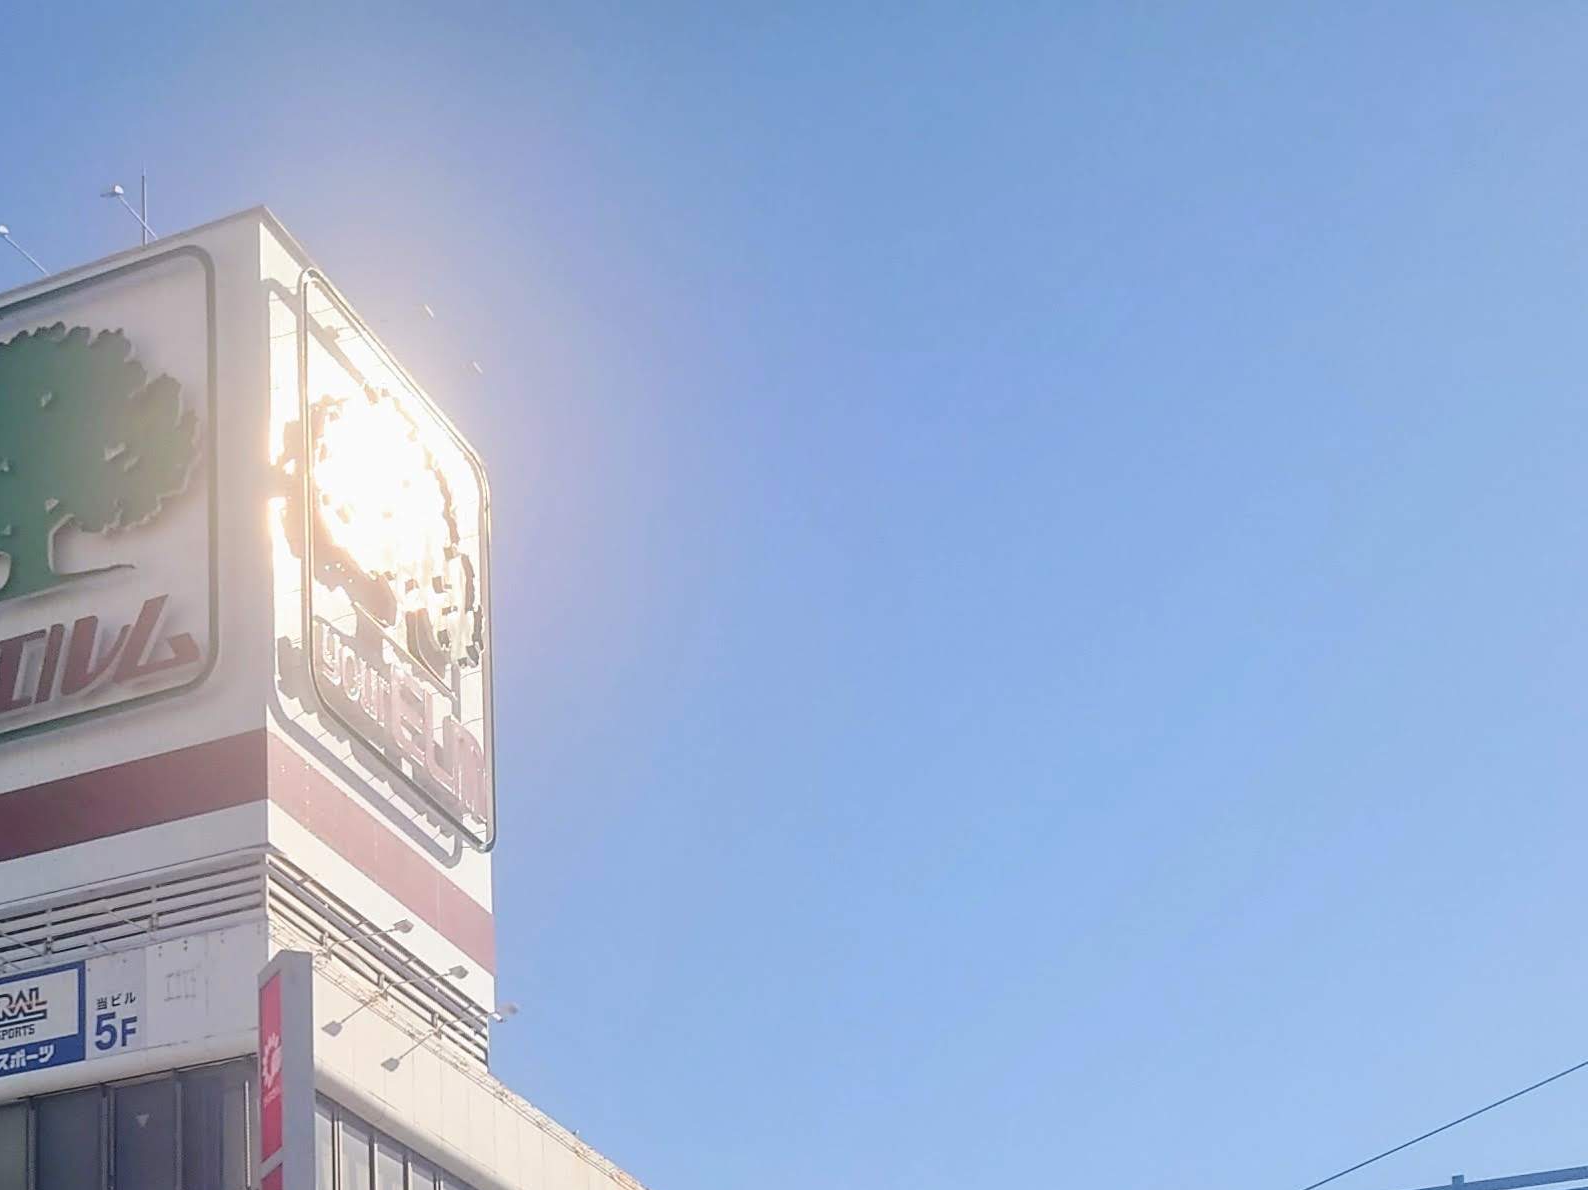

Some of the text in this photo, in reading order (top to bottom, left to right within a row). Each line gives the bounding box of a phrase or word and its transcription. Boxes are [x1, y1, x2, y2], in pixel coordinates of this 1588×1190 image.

[96, 991, 137, 1011] 当ビル
[95, 1011, 138, 1051] 5F
